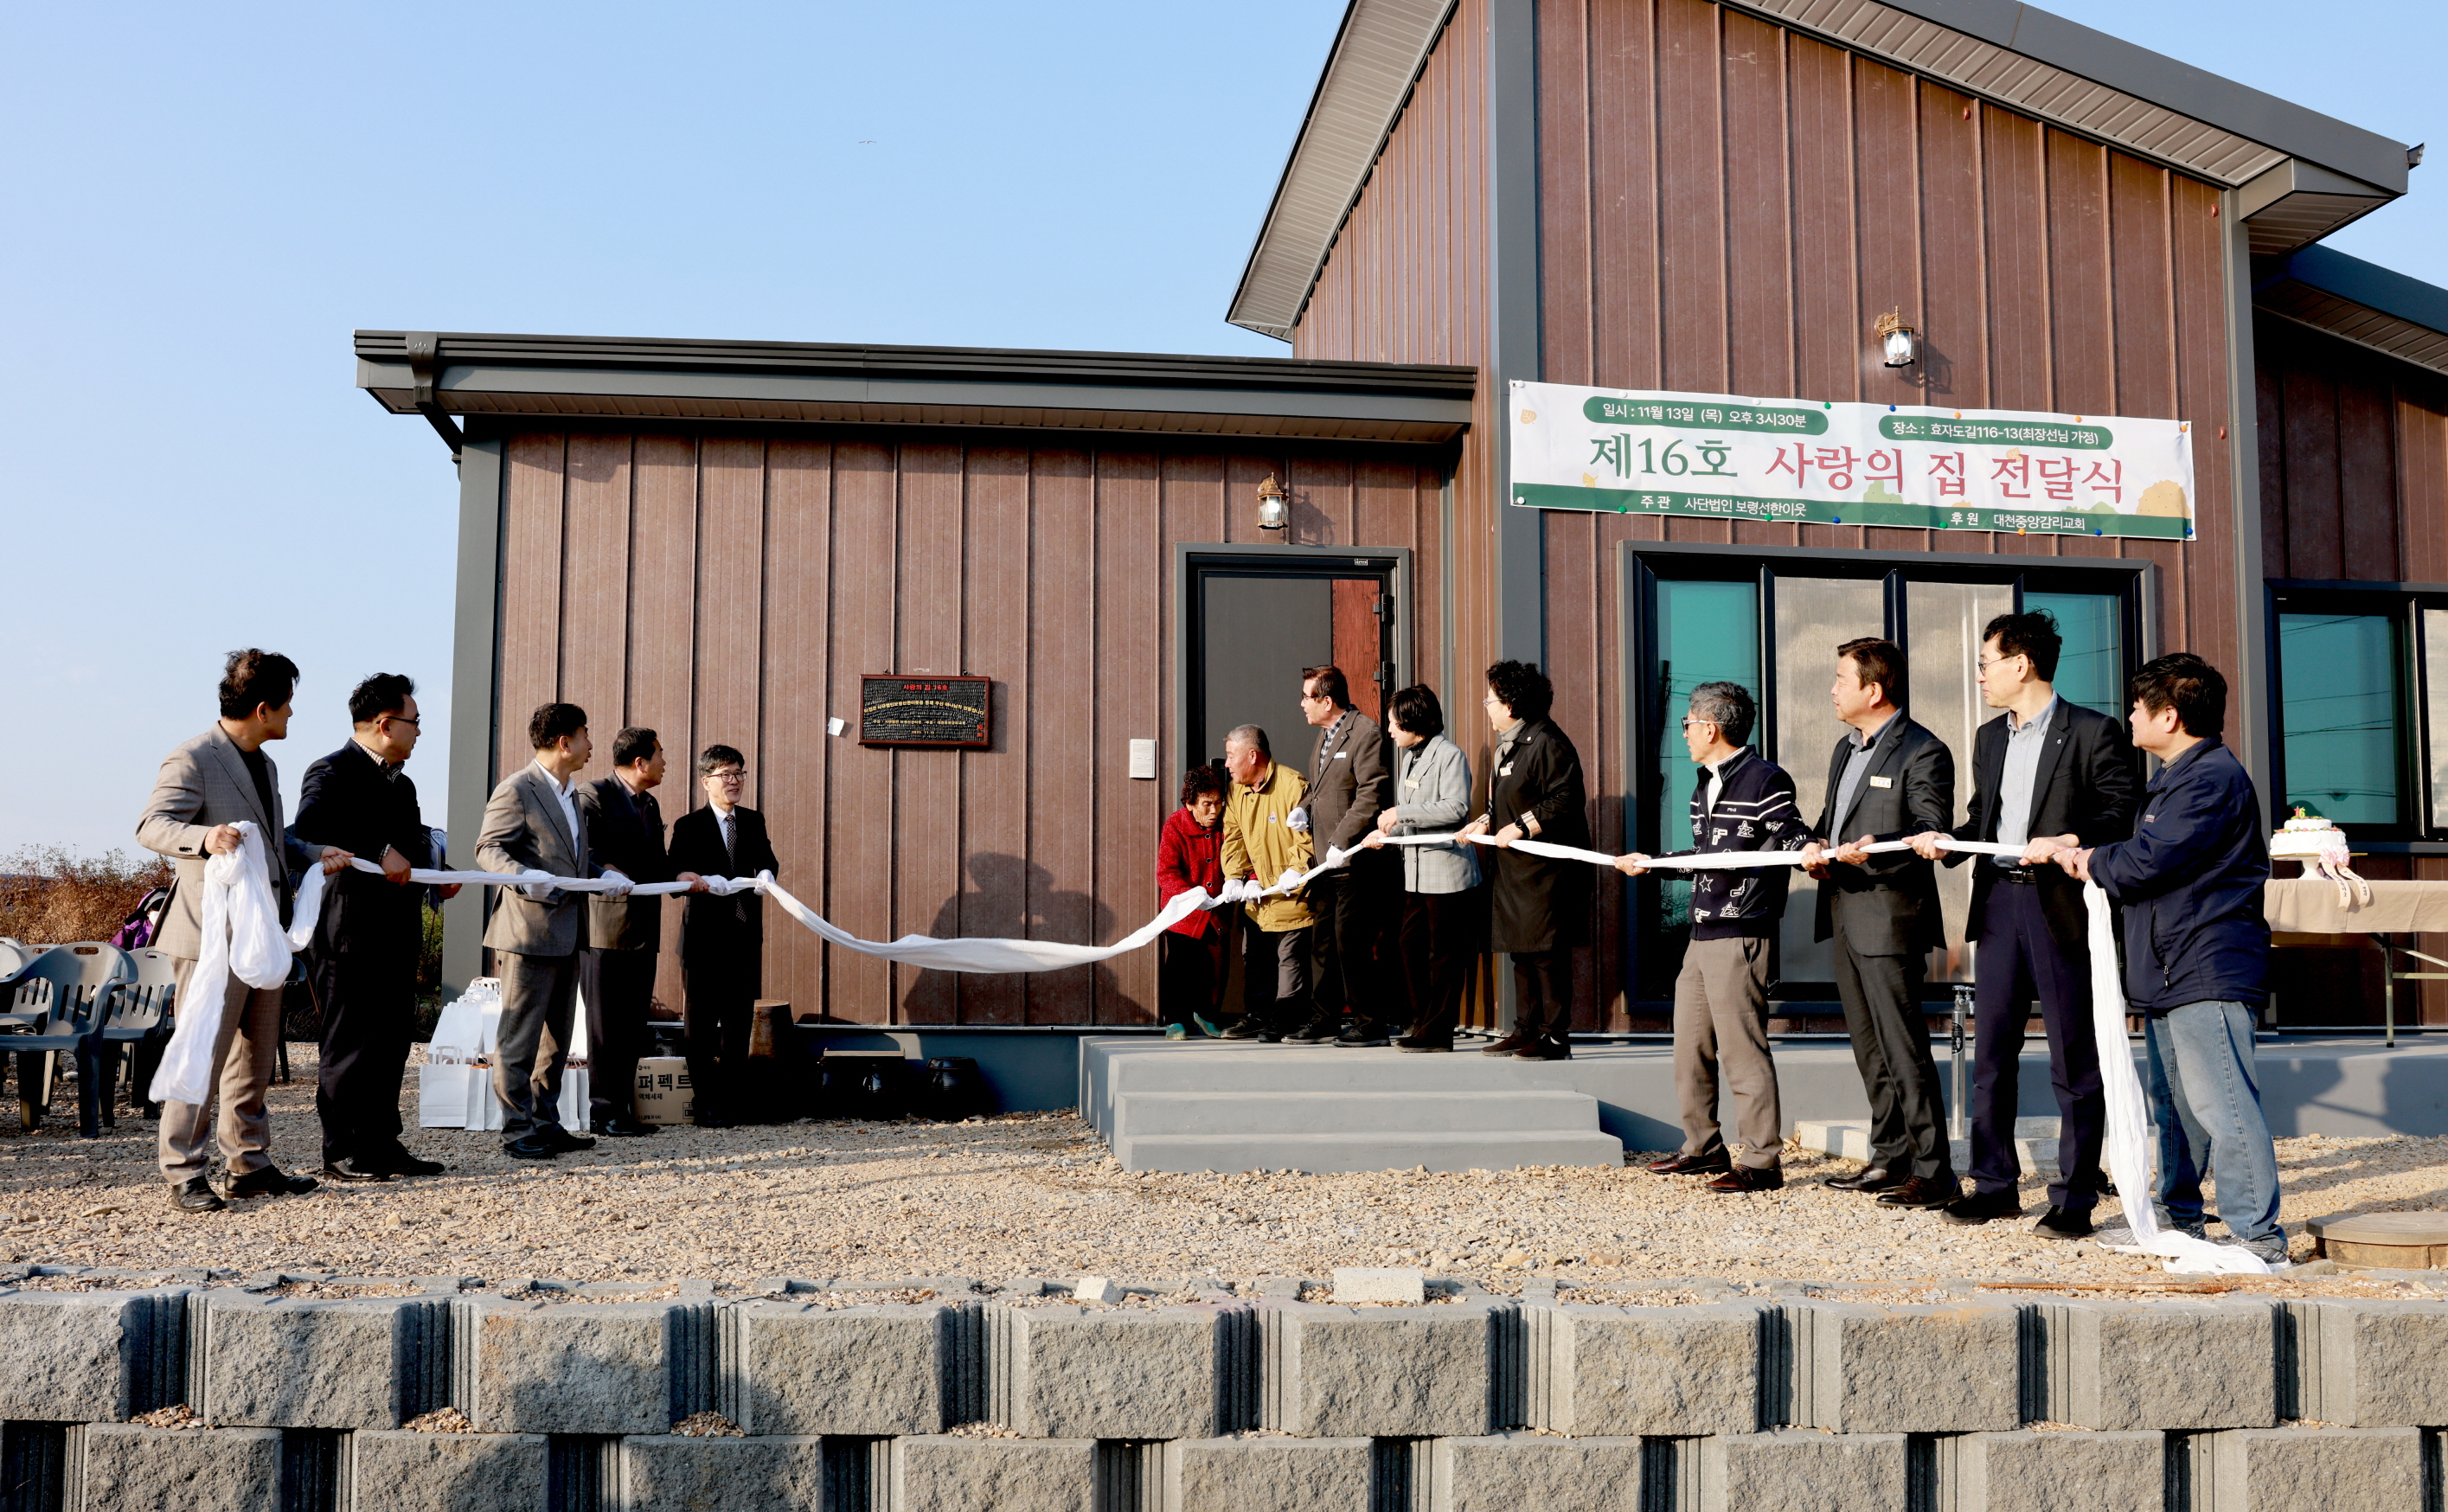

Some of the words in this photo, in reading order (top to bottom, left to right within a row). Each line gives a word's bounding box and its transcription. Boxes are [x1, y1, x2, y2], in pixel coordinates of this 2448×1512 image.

[1603, 403, 1628, 418] 일시
[1637, 405, 1663, 420] 11월
[1666, 407, 1694, 421] 13일
[1701, 408, 1723, 423] (목)
[1728, 410, 1753, 425] 오후
[1756, 412, 1807, 428] 3시30분
[1892, 421, 1919, 434] 장소
[2071, 431, 2099, 445] 가정)
[1589, 432, 1738, 480] 제16호
[1765, 441, 1903, 494] 사랑의
[1927, 451, 1965, 497] 집
[1990, 453, 2122, 504] 전달식
[1684, 497, 1733, 512] 사단법인
[1735, 500, 1807, 517] 보령선한이웃
[1993, 513, 2086, 531] 대천중앙감리교회
[2294, 807, 2306, 818] 16
